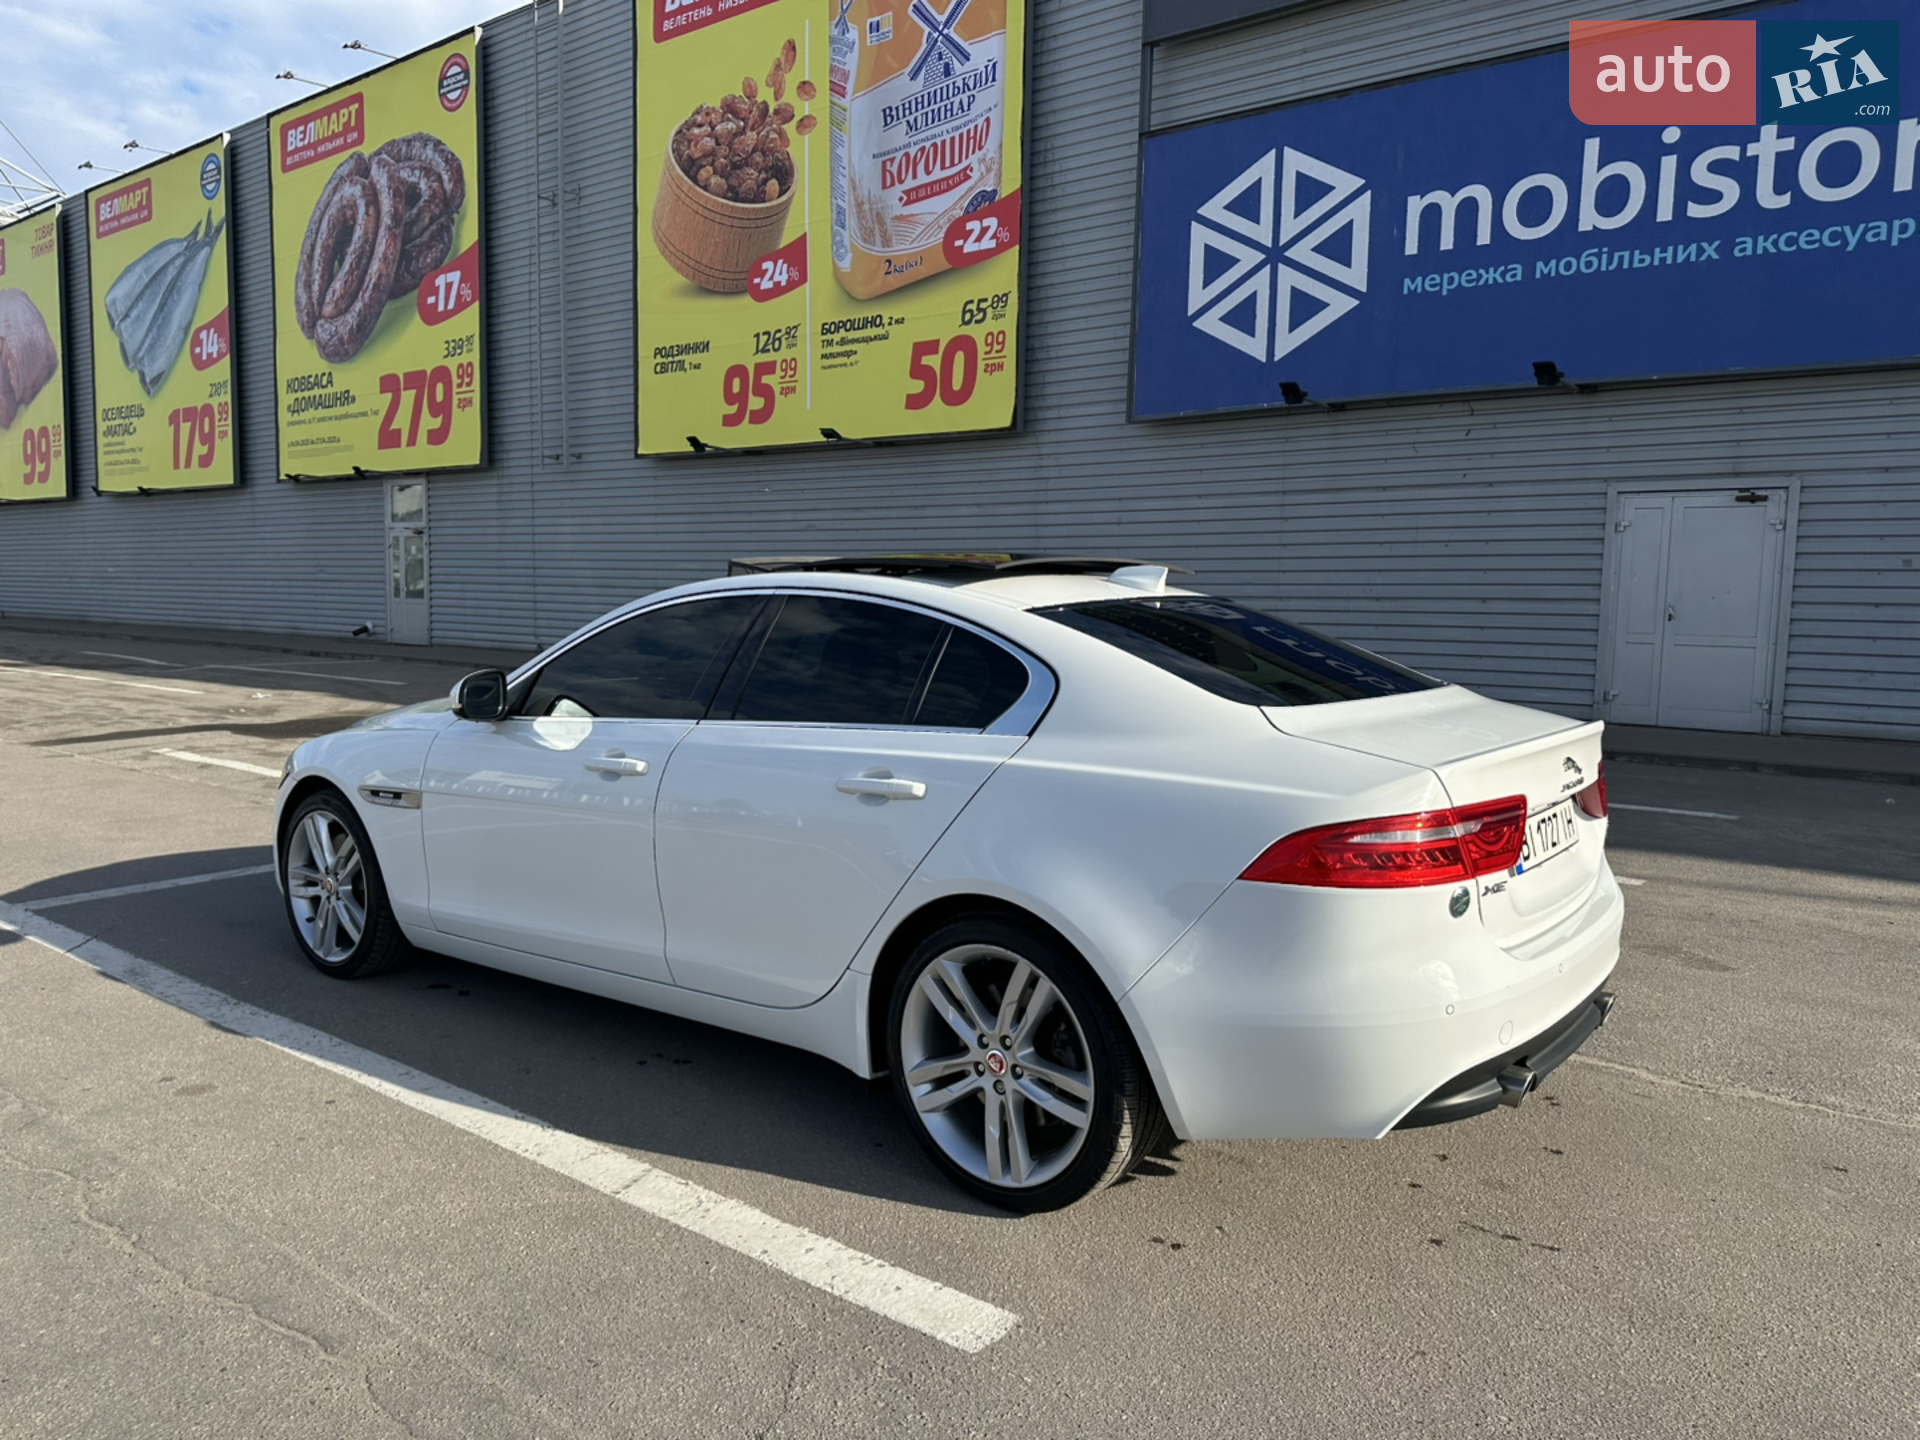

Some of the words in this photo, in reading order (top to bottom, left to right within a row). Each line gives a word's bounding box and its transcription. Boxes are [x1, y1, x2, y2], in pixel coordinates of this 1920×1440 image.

[662, 5, 713, 32] ВЕЛЕТЕНЬ
[881, 57, 998, 128] ВІННИЦЬКИЙ
[287, 102, 359, 152] ВЕЛМАРТ
[904, 94, 976, 136] МЛИНАР
[880, 116, 992, 190] БОРОШНО
[910, 171, 966, 200] ПШЕНИЧНЕ
[1404, 117, 1920, 256] mobistor
[100, 186, 149, 222] ВЕЛМАРТ
[35, 222, 54, 243] ТОВАР
[954, 217, 1010, 253] -22%
[1403, 260, 1523, 295] мережа
[1534, 237, 1720, 280] мобільних
[1733, 216, 1916, 257] аксесуар
[426, 270, 472, 313] -17%
[753, 258, 800, 291] -24%
[194, 327, 227, 359] -14%
[820, 314, 885, 337] БОРОШНО,
[887, 316, 894, 327] 2
[894, 316, 906, 326] кг
[821, 338, 835, 349] ТМ
[653, 340, 711, 360] РОДЗИНКИ
[653, 359, 688, 375] СВІТЛІ,
[285, 371, 334, 395] КОВБАСА
[904, 333, 979, 411] 50
[983, 360, 1005, 377] грн
[286, 389, 357, 417] «ДОМАШНЯ»
[377, 364, 454, 451] 279
[457, 395, 474, 412] грн
[721, 359, 778, 428] 95
[779, 384, 797, 398] грн
[102, 403, 145, 423] ОСЕЛЕДЕЦЬ
[167, 402, 216, 471] 179
[1537, 812, 1561, 853] 1727
[1560, 804, 1576, 841] IH
